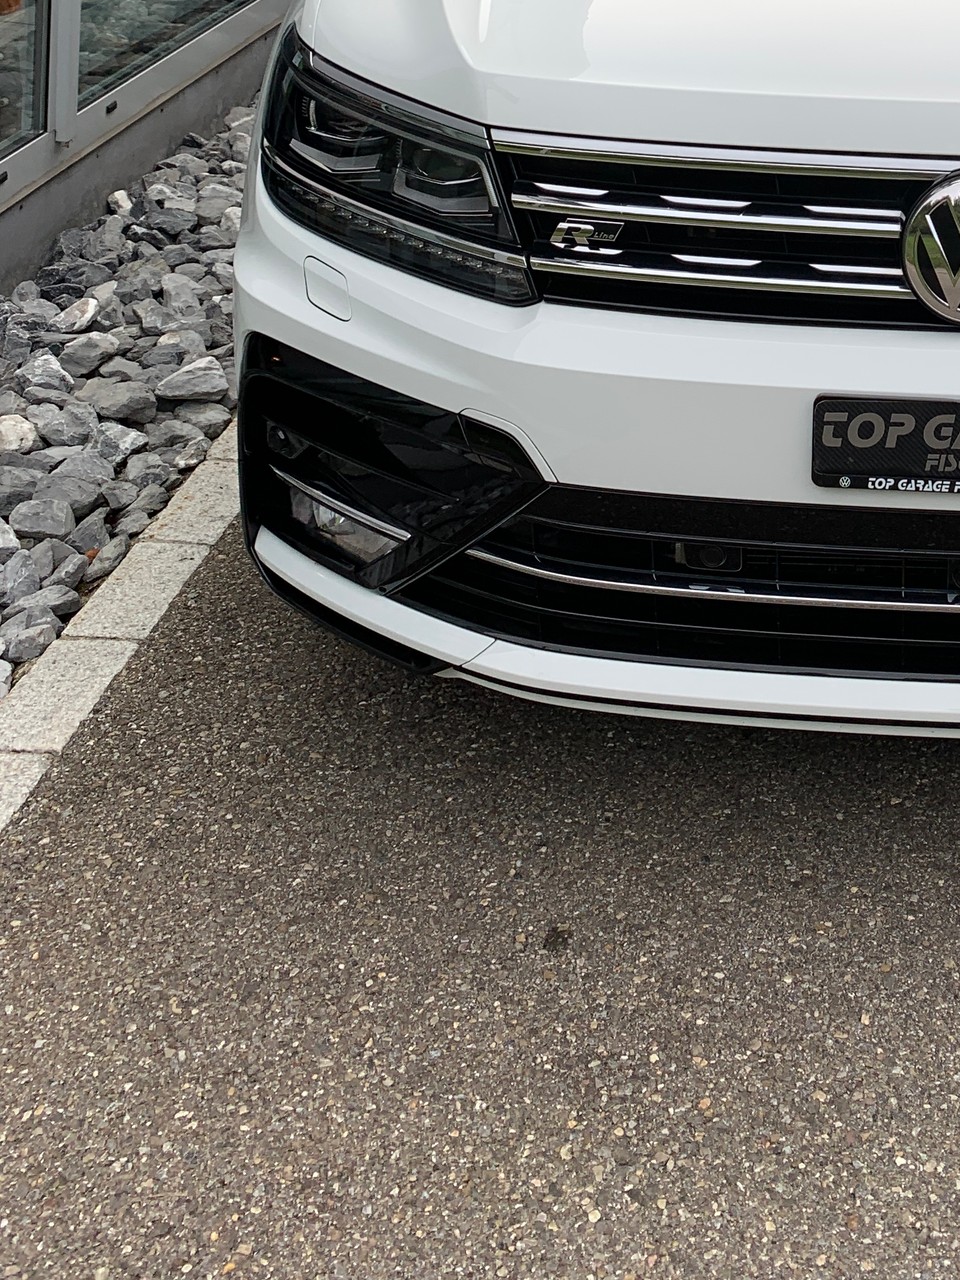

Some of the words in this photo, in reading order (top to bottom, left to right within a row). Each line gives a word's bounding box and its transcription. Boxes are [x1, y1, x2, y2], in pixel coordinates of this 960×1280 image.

[821, 411, 916, 449] TOP
[868, 477, 894, 490] TOP
[898, 478, 951, 493] GARAGE
